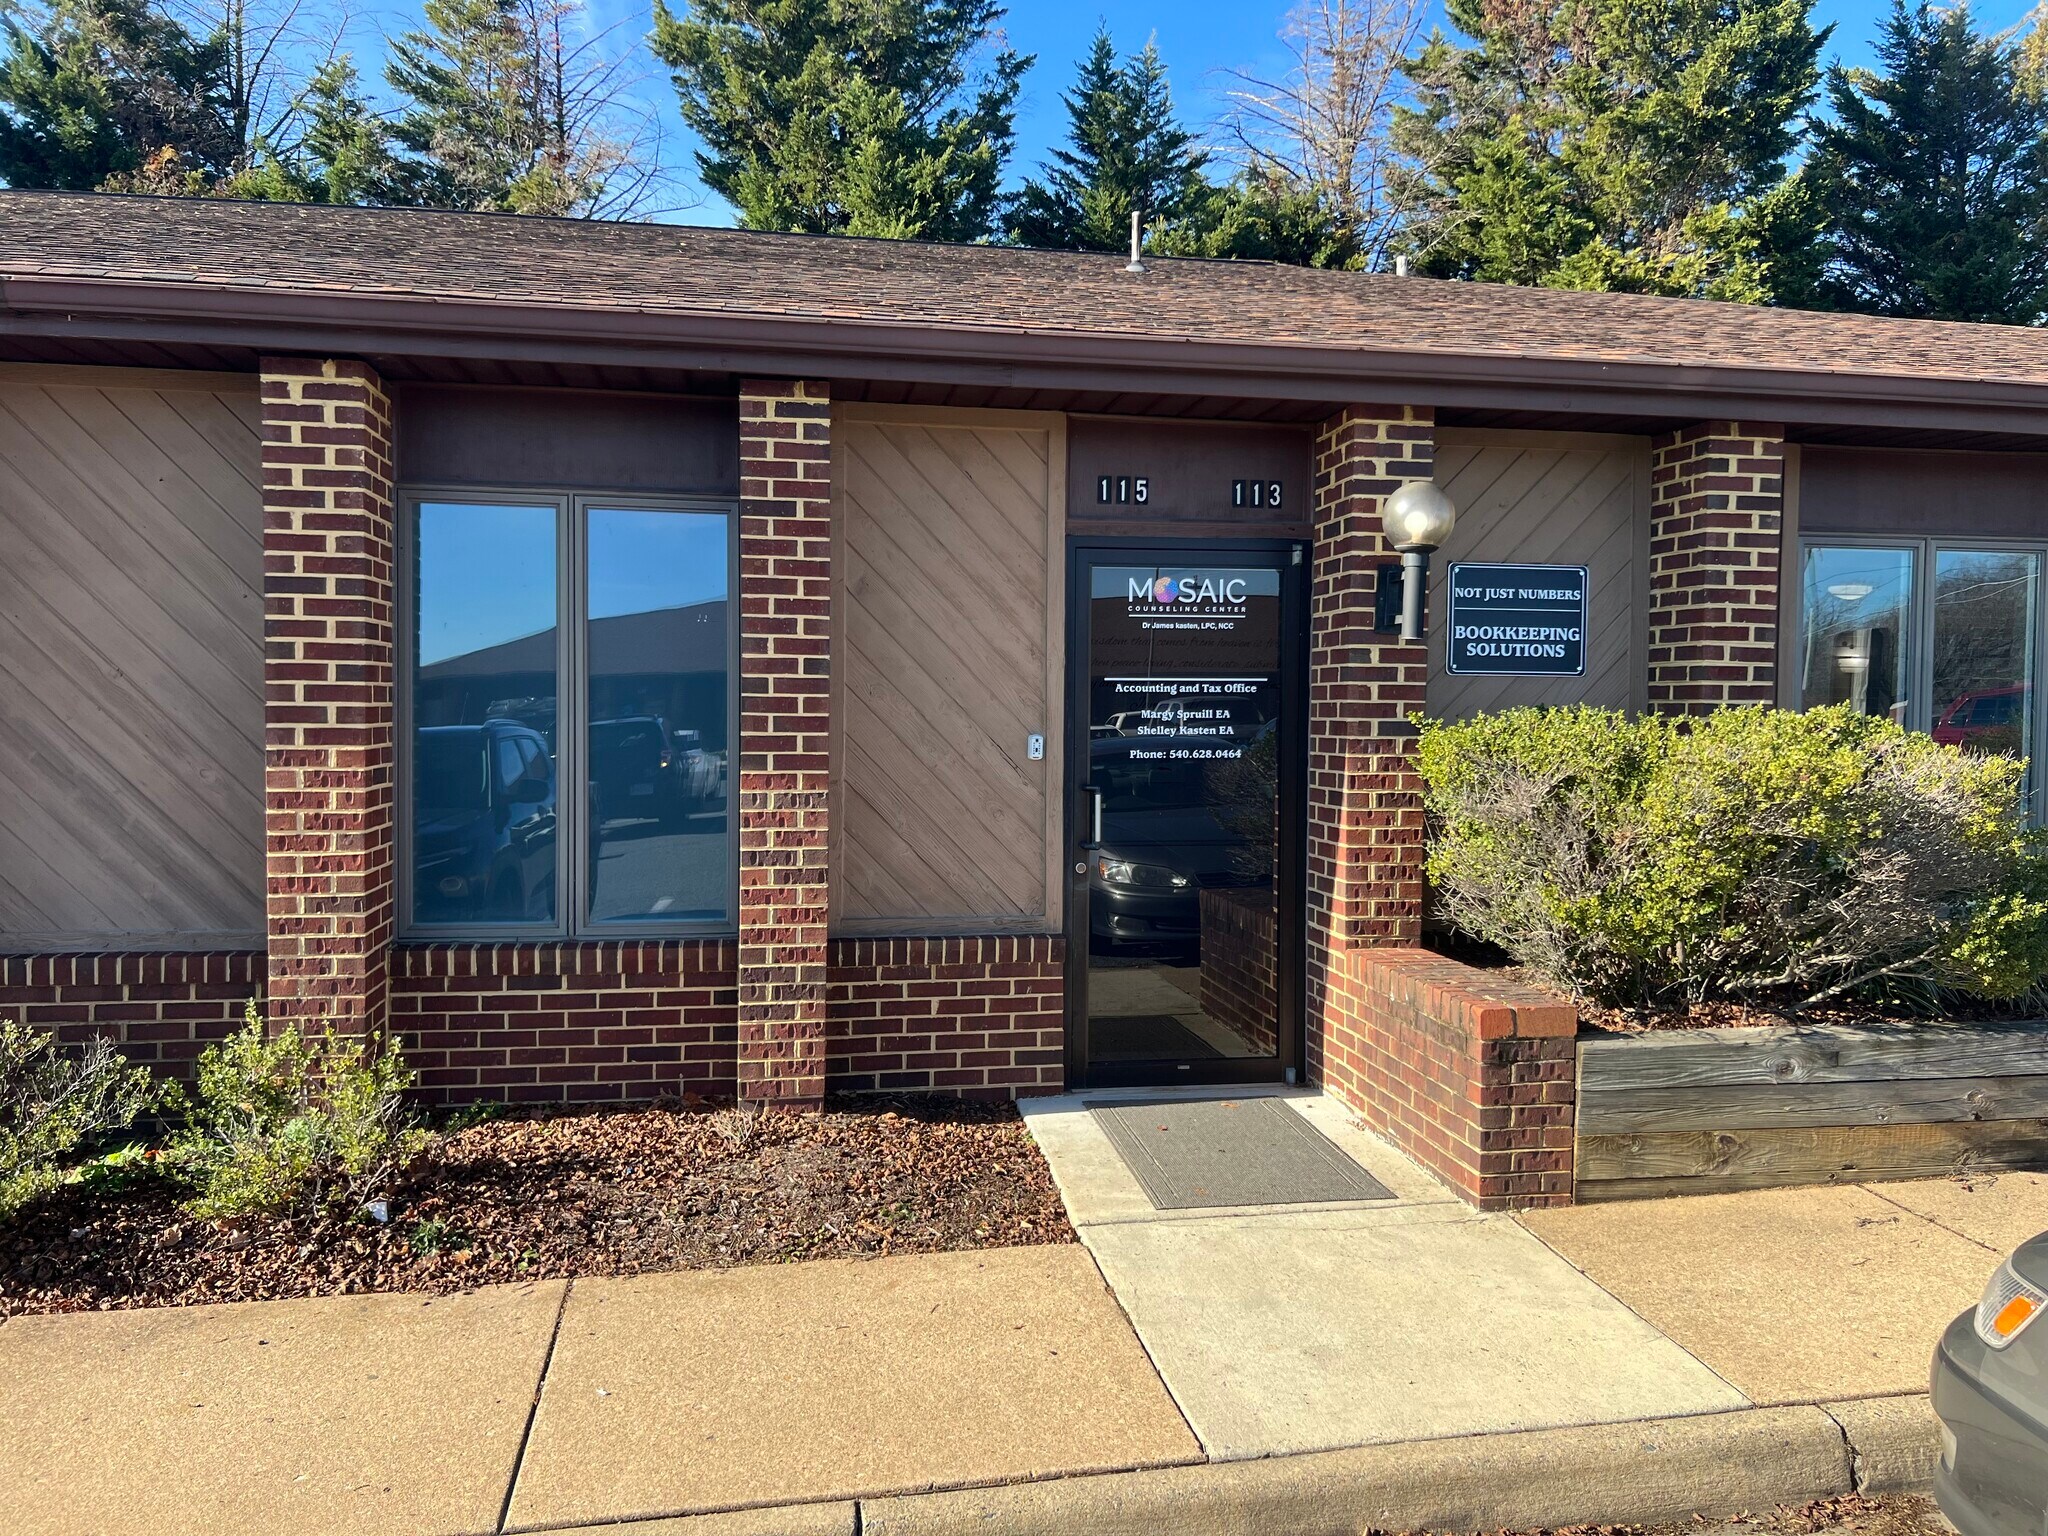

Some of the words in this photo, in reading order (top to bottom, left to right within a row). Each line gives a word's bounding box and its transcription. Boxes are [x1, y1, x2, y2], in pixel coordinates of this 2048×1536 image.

[1101, 479, 1148, 503] 115
[1235, 482, 1281, 506] 113
[1128, 576, 1247, 604] MOSAIC
[1454, 587, 1482, 598] NOT
[1484, 588, 1515, 601] JUST
[1518, 589, 1581, 601] NUMBERS
[1175, 622, 1200, 630] kasten,
[1201, 622, 1217, 630] LPC,
[1218, 622, 1234, 630] NCC
[1454, 625, 1580, 641] BOOKKEEPING
[1466, 643, 1566, 658] SOLUTIONS
[1115, 684, 1178, 695] Accounting
[1179, 684, 1200, 693] and
[1201, 684, 1222, 693] Tax
[1224, 684, 1257, 693] Office
[1141, 710, 1174, 721] Margy
[1176, 710, 1213, 720] Spruill
[1215, 710, 1230, 719] EA
[1137, 726, 1177, 737] Shelley
[1179, 726, 1216, 735] Kasten
[1219, 726, 1234, 735] EA
[1129, 750, 1167, 759] Phone:
[1169, 749, 1242, 759] 540.628.0464
